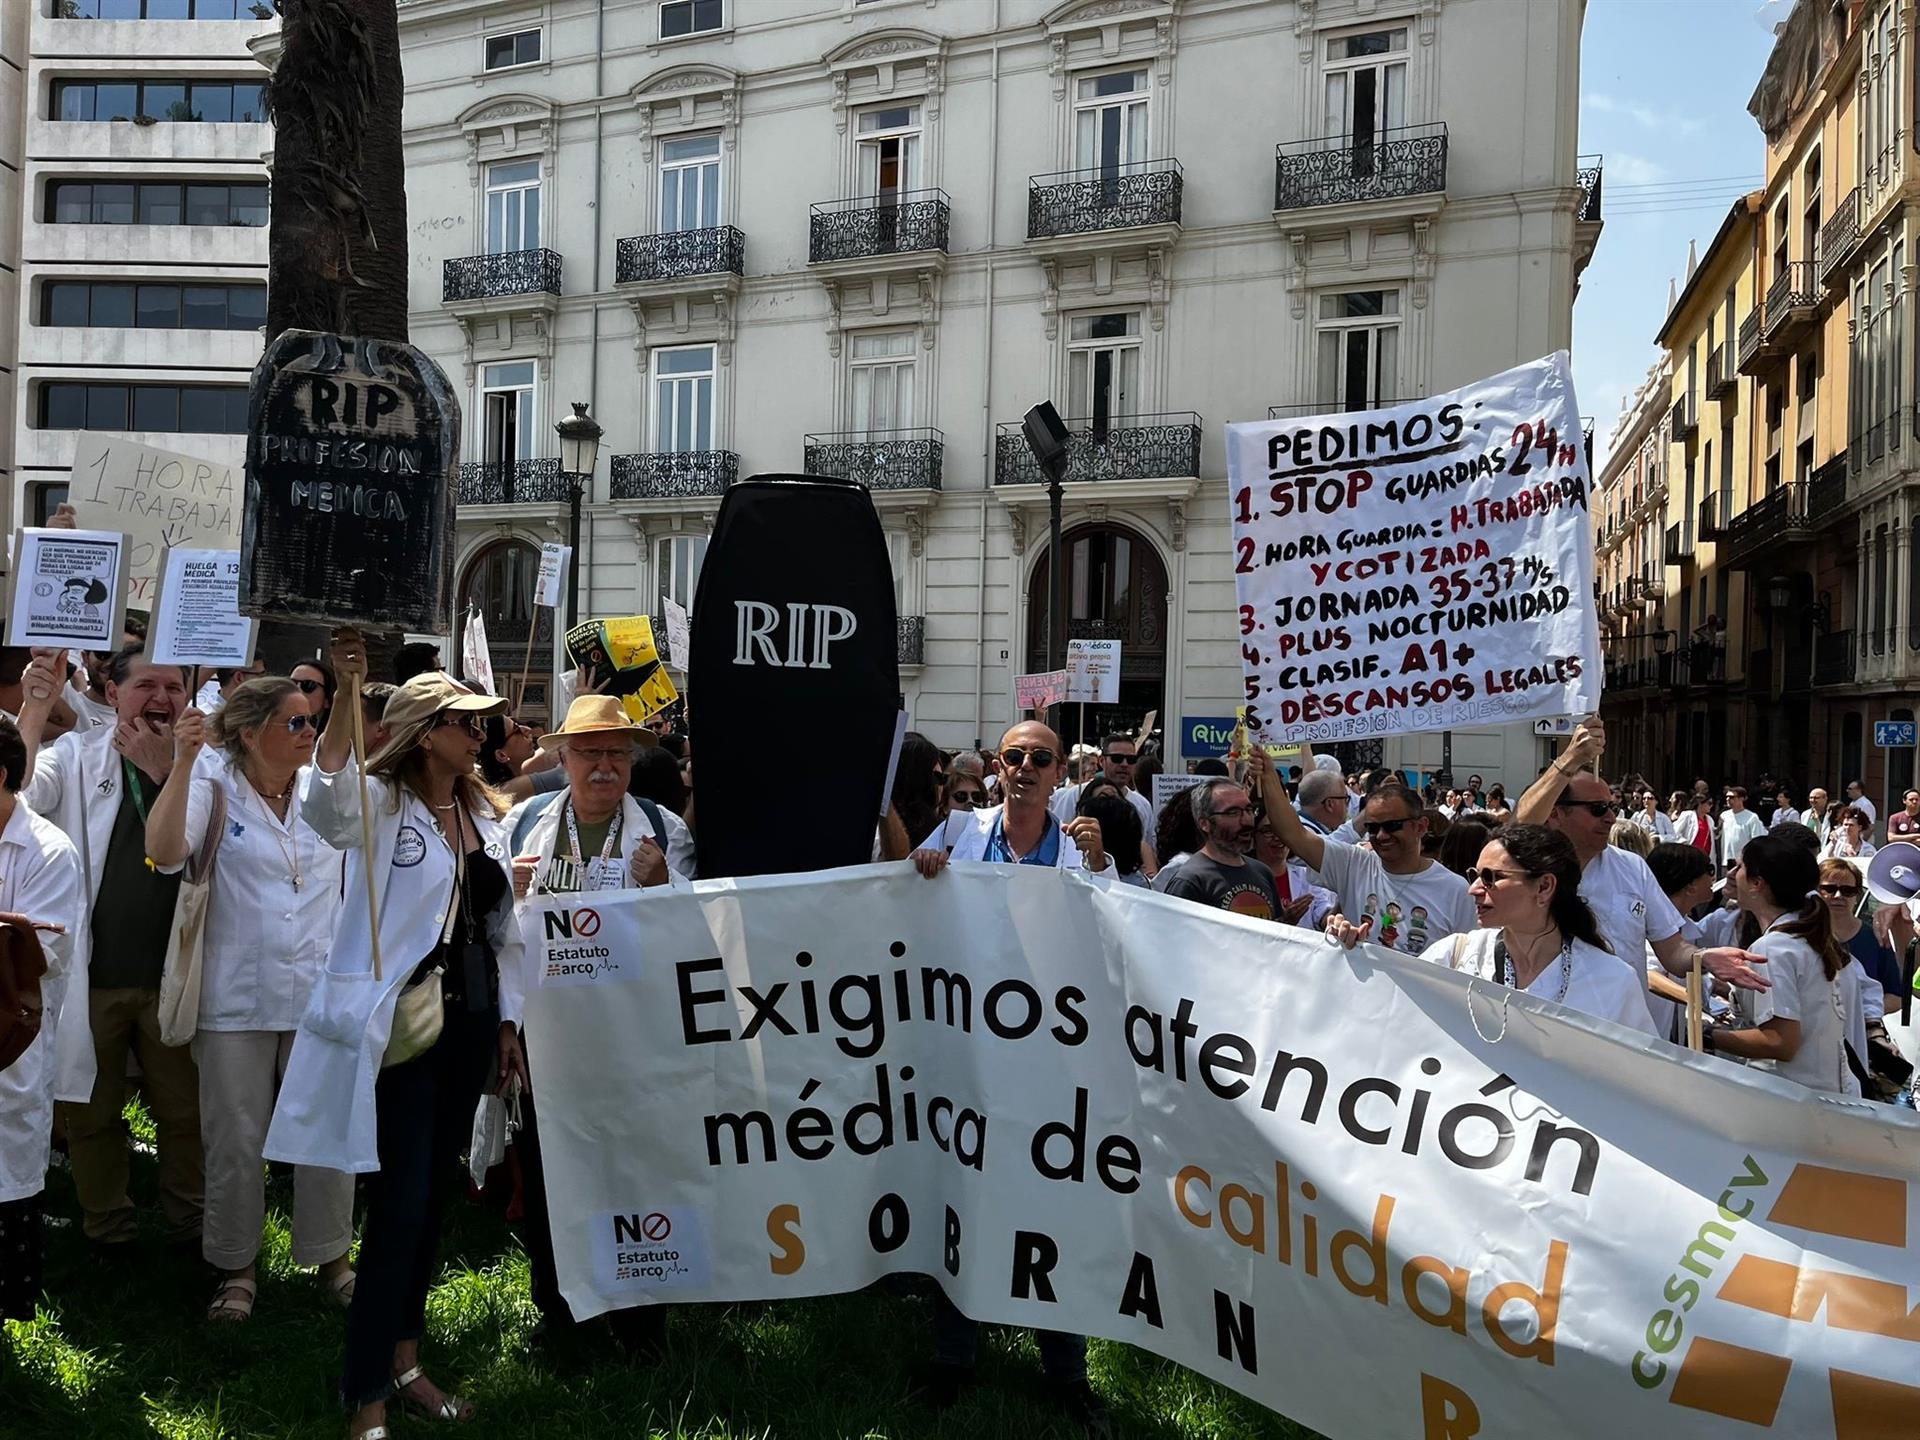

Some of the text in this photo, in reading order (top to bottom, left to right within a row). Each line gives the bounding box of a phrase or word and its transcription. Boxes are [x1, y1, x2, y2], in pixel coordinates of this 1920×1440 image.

[310, 378, 399, 429] RIP
[1268, 403, 1483, 470] PEDIMOS:
[85, 448, 235, 505] 1 HORA
[291, 479, 407, 522] MEDICA
[1235, 486, 1260, 523] 1.
[1270, 470, 1373, 517] STOP
[1385, 447, 1507, 504] GUARDIAS
[185, 562, 218, 570] HUELGA
[1236, 537, 1260, 574] 2.
[1265, 534, 1331, 566] HORA
[1239, 604, 1265, 636] 3.
[1275, 583, 1420, 627] JORNADA
[1429, 557, 1516, 609] 35-37
[732, 600, 858, 670] RIP
[1242, 585, 1570, 666] 4. PLUS NOCTURNIDAD
[1245, 675, 1273, 701] 5.
[1279, 654, 1391, 690] CLASIF.
[1281, 673, 1475, 725] DESCANSOS
[1485, 655, 1583, 696] LEGALES
[1412, 705, 1443, 728] DE
[548, 946, 610, 961] Estatuto
[674, 940, 1601, 1196] Exigimos atención
[703, 1062, 1569, 1367] médica de calidad
[617, 1249, 680, 1265] Estatuto
